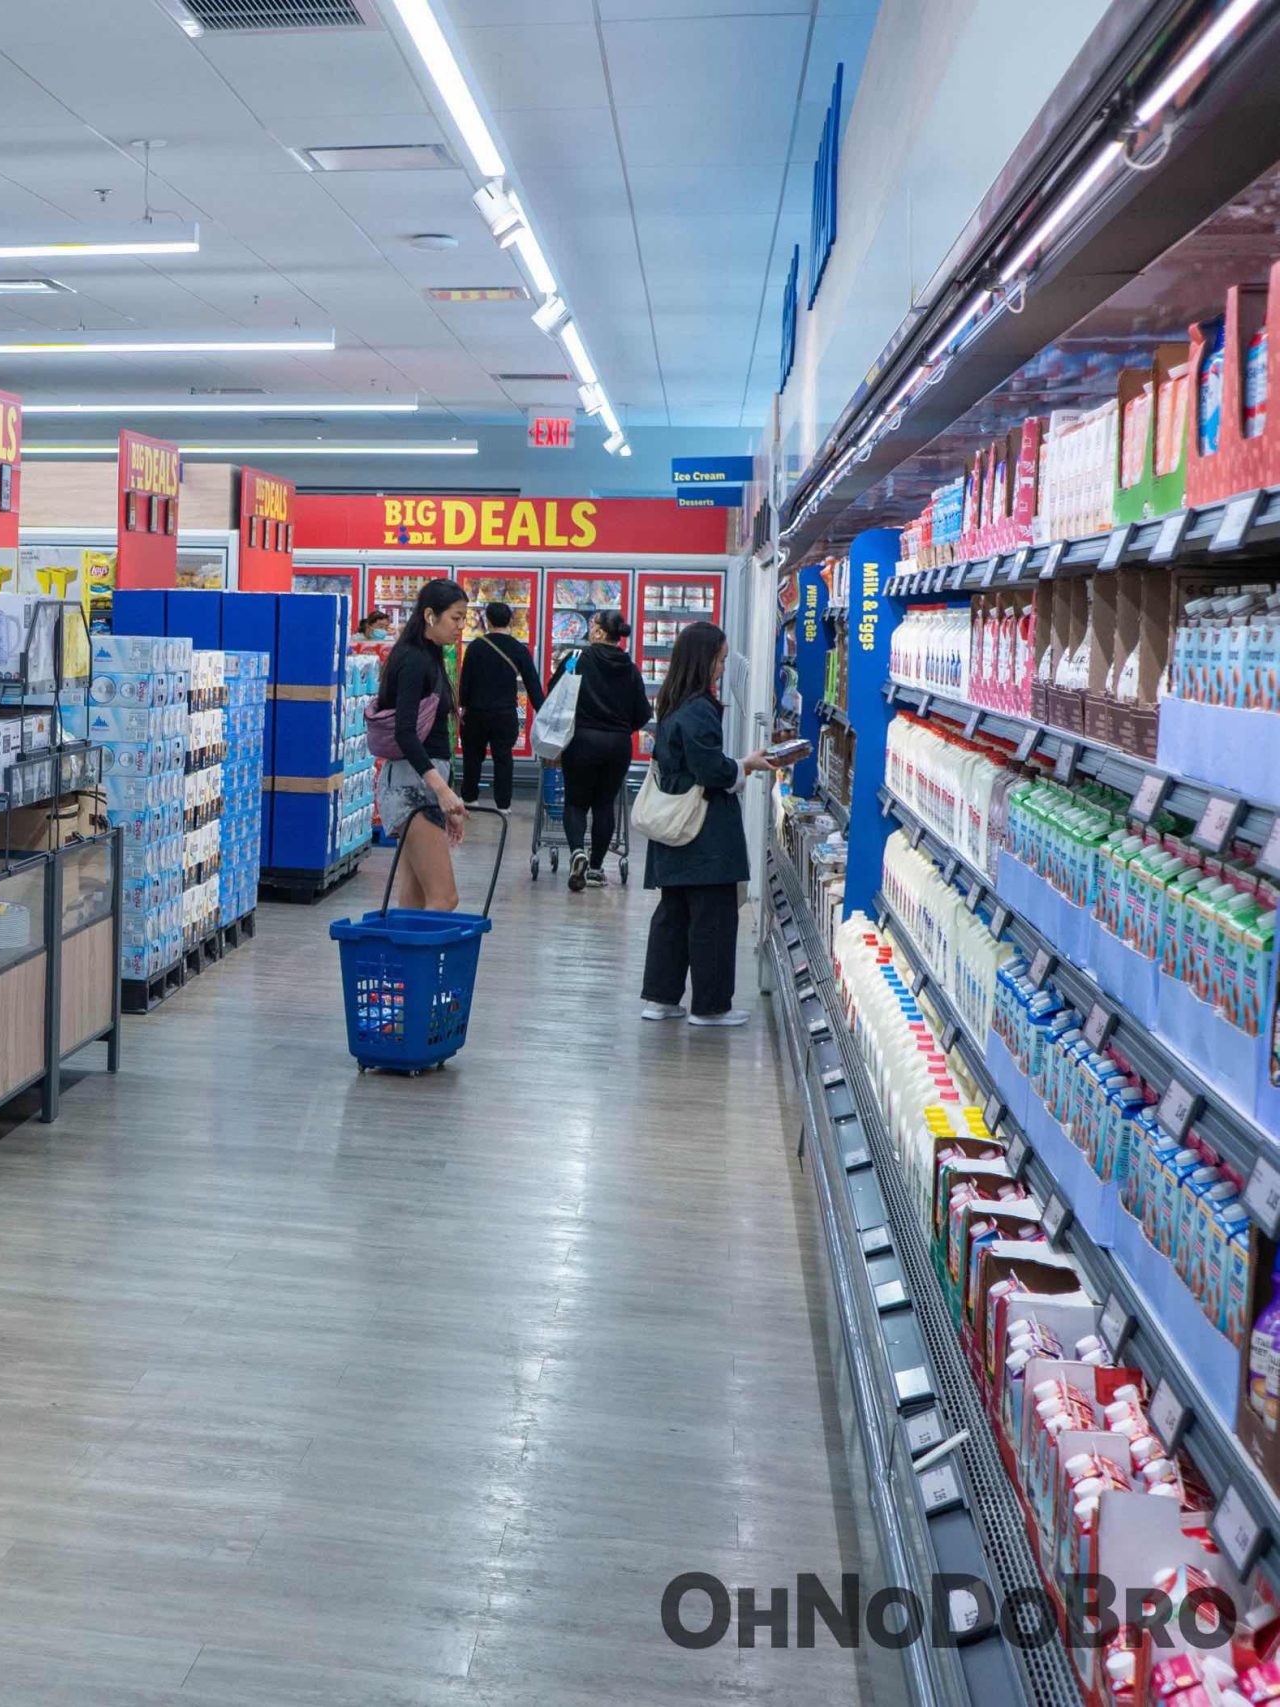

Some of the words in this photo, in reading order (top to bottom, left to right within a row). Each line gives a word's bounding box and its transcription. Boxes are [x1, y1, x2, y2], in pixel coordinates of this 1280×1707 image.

[535, 418, 570, 446] EXIT
[131, 442, 145, 470] BIG
[144, 446, 177, 496] DEALS
[674, 472, 691, 482] Ice
[693, 472, 726, 482] Cream
[264, 480, 288, 522] DEALS
[679, 497, 715, 507] Desserts
[384, 500, 437, 526] BIG
[441, 501, 597, 547] DEALS
[863, 562, 879, 597] Milk
[862, 600, 879, 612] &
[858, 614, 878, 651] Eggs
